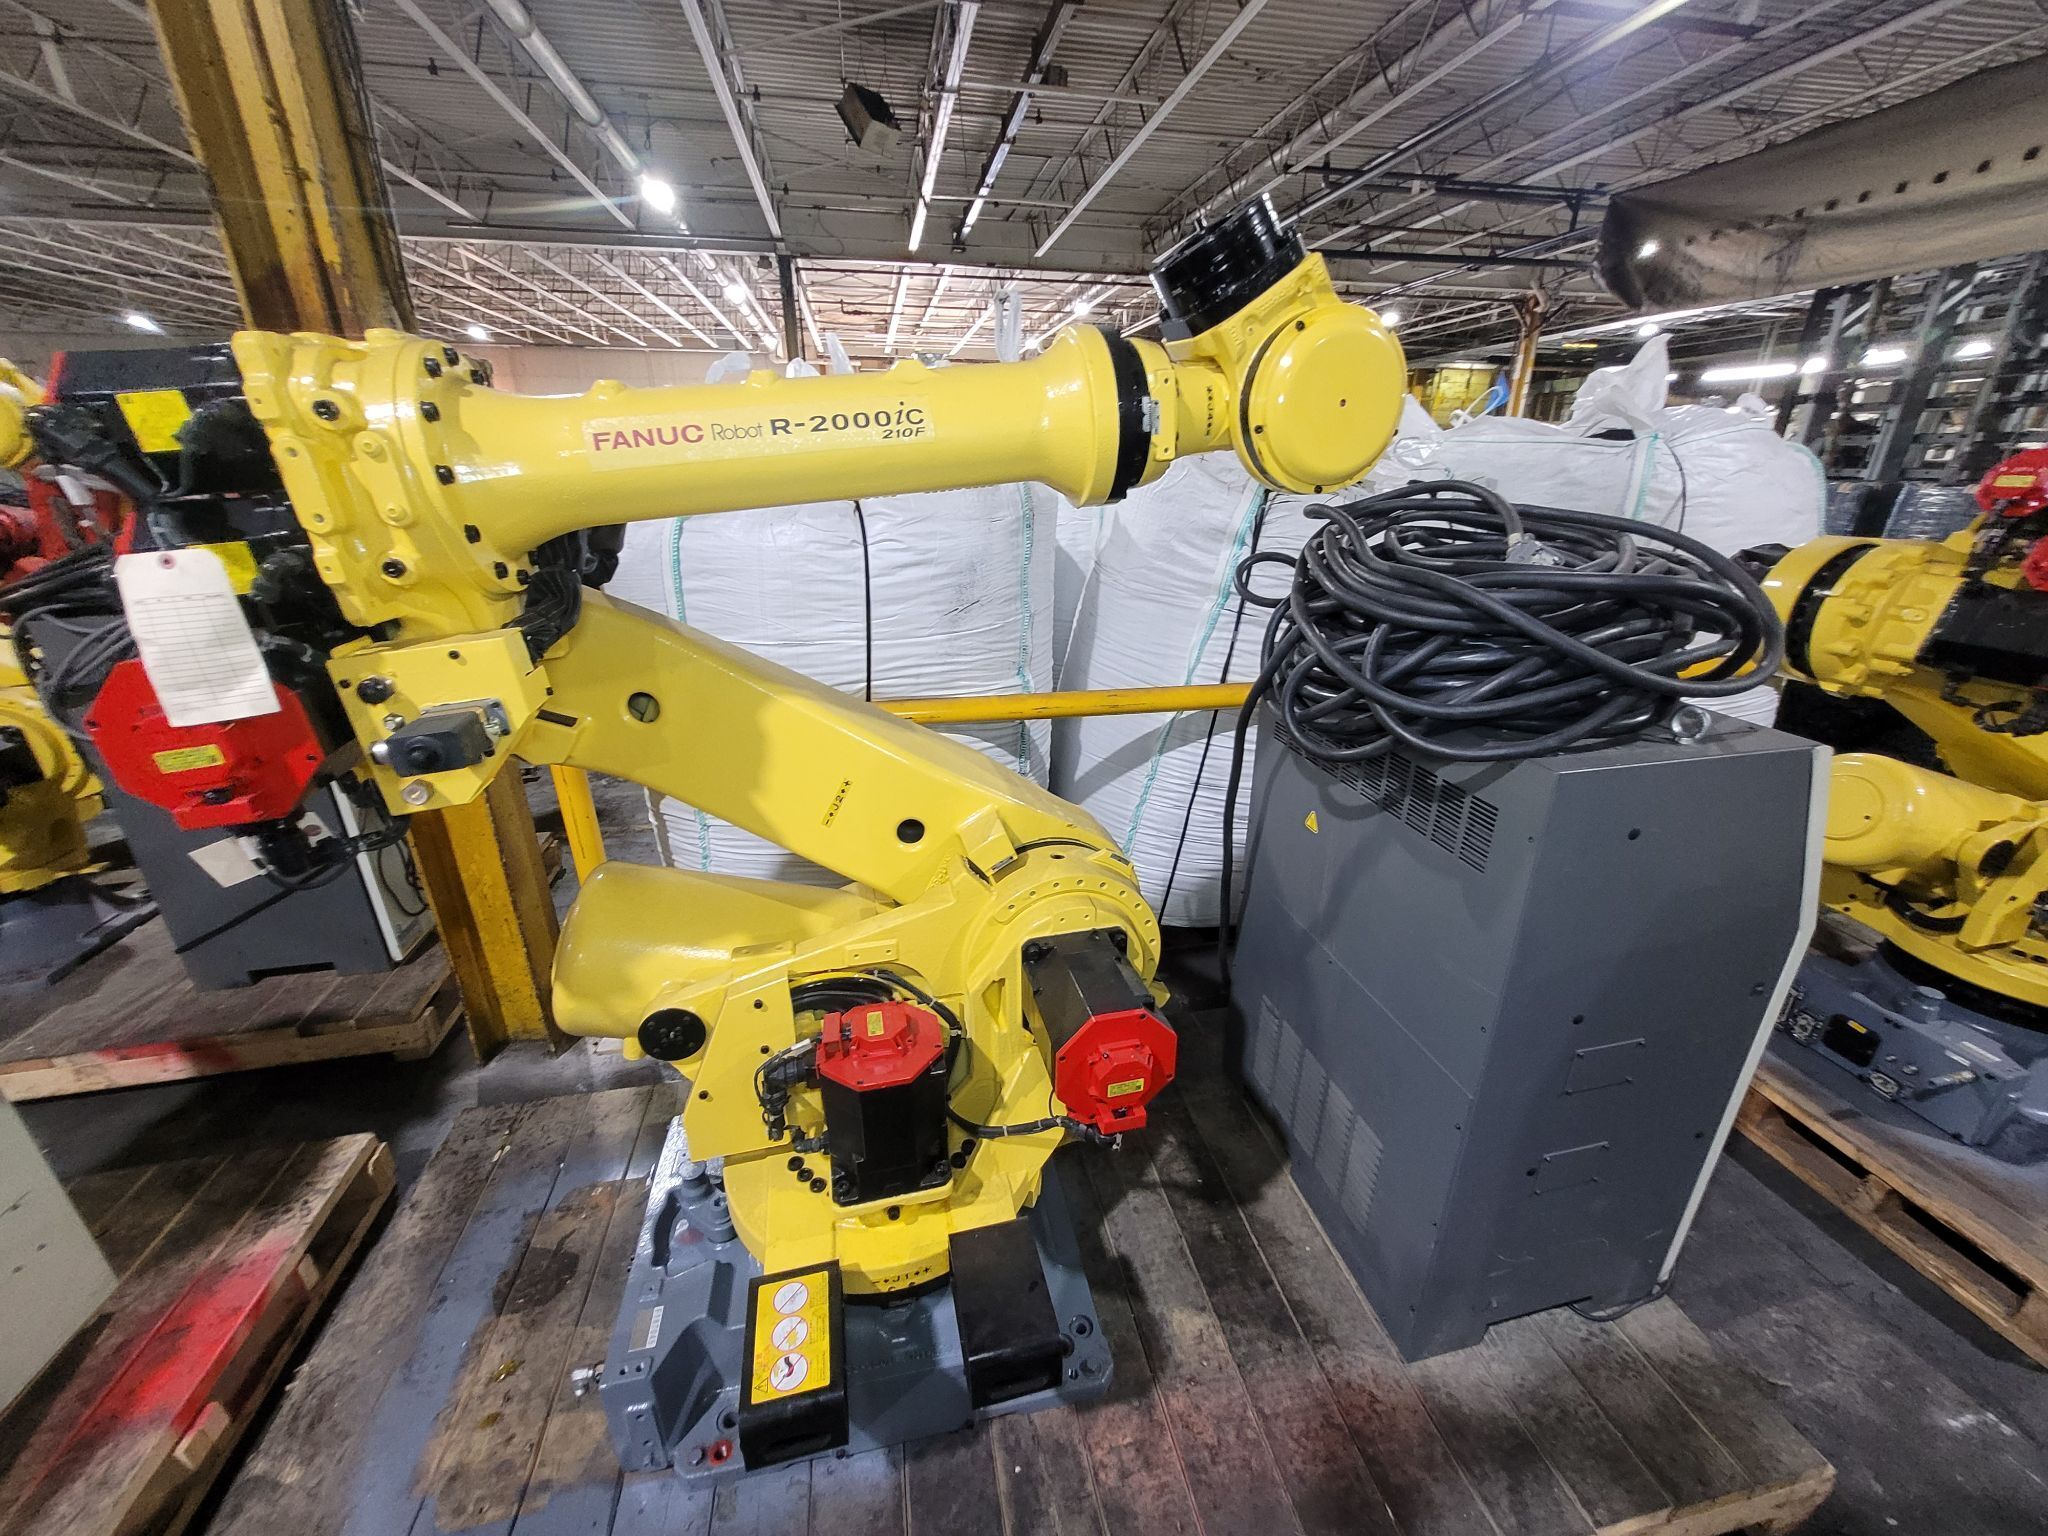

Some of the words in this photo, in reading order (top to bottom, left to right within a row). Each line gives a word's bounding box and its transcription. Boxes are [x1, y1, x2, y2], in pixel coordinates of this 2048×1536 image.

[592, 424, 704, 451] FANUC
[711, 422, 764, 441] Robot
[769, 401, 925, 436] R-2000iC
[881, 427, 926, 440] 210F
